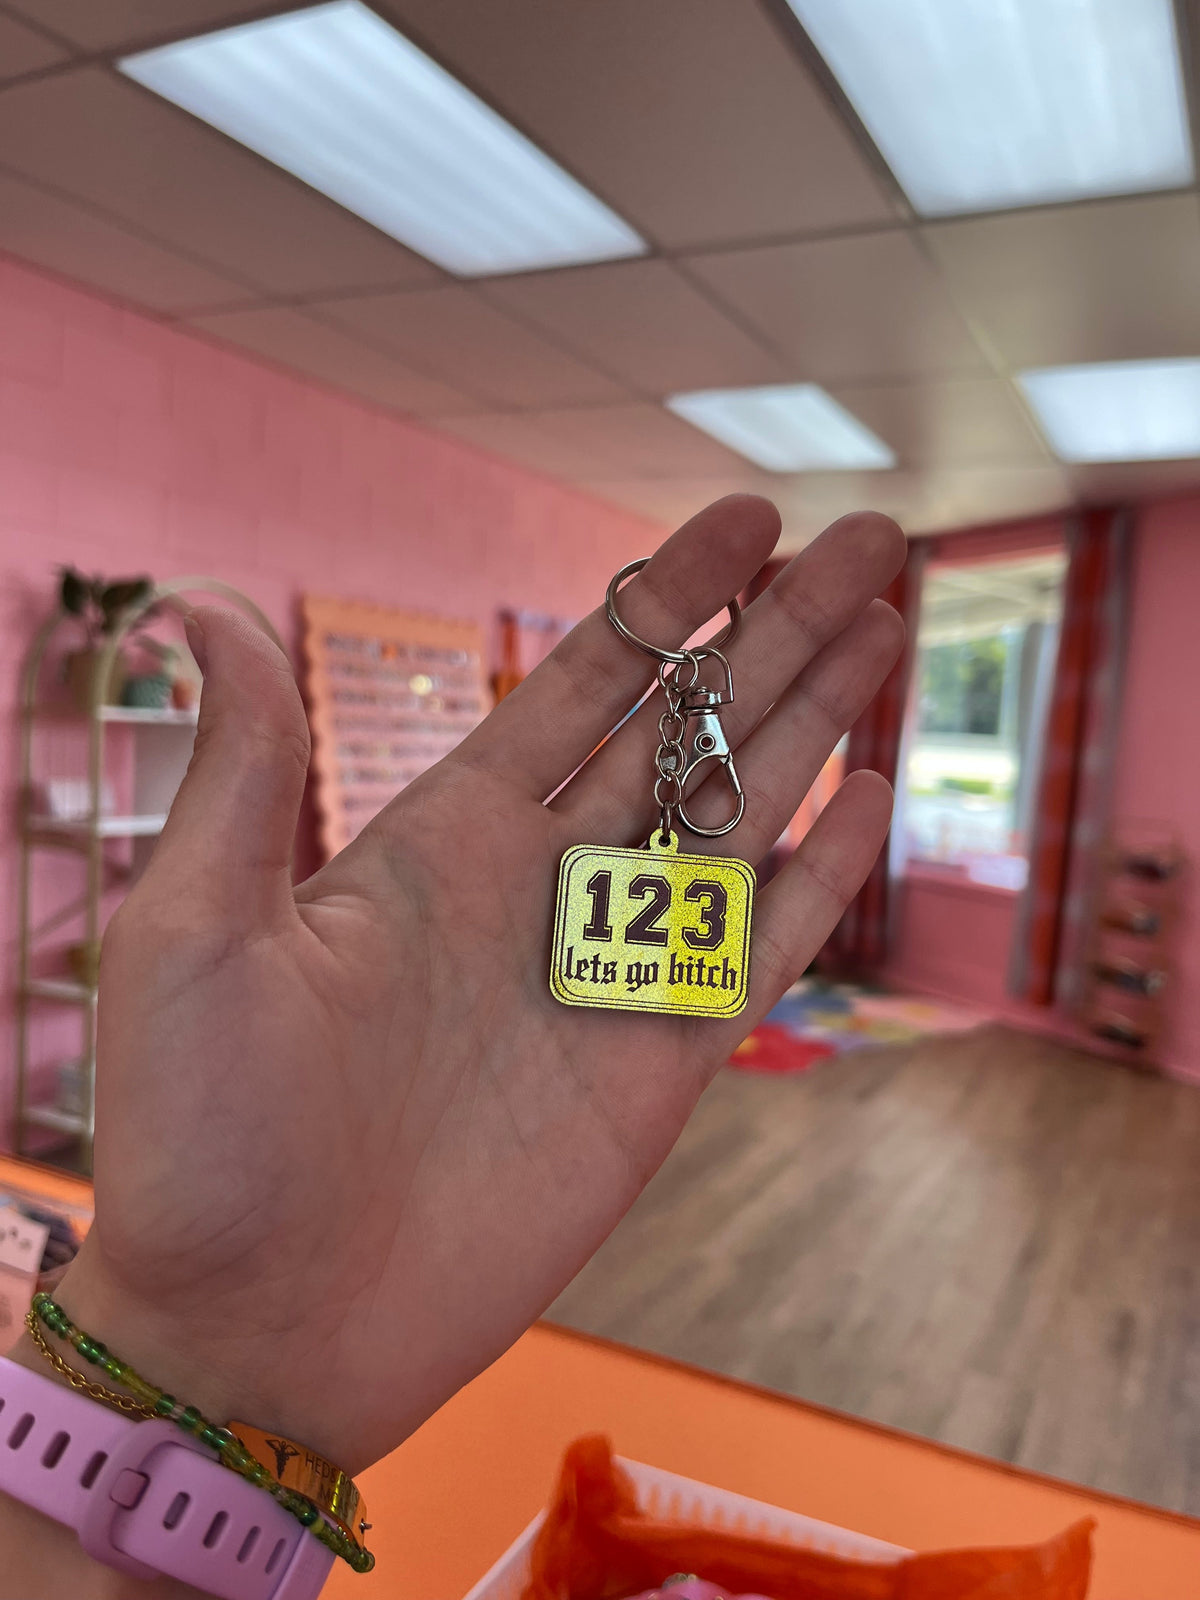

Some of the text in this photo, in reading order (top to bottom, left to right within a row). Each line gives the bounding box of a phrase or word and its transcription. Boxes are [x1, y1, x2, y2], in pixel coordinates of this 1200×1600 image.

[563, 945, 738, 993] lets go bitch
